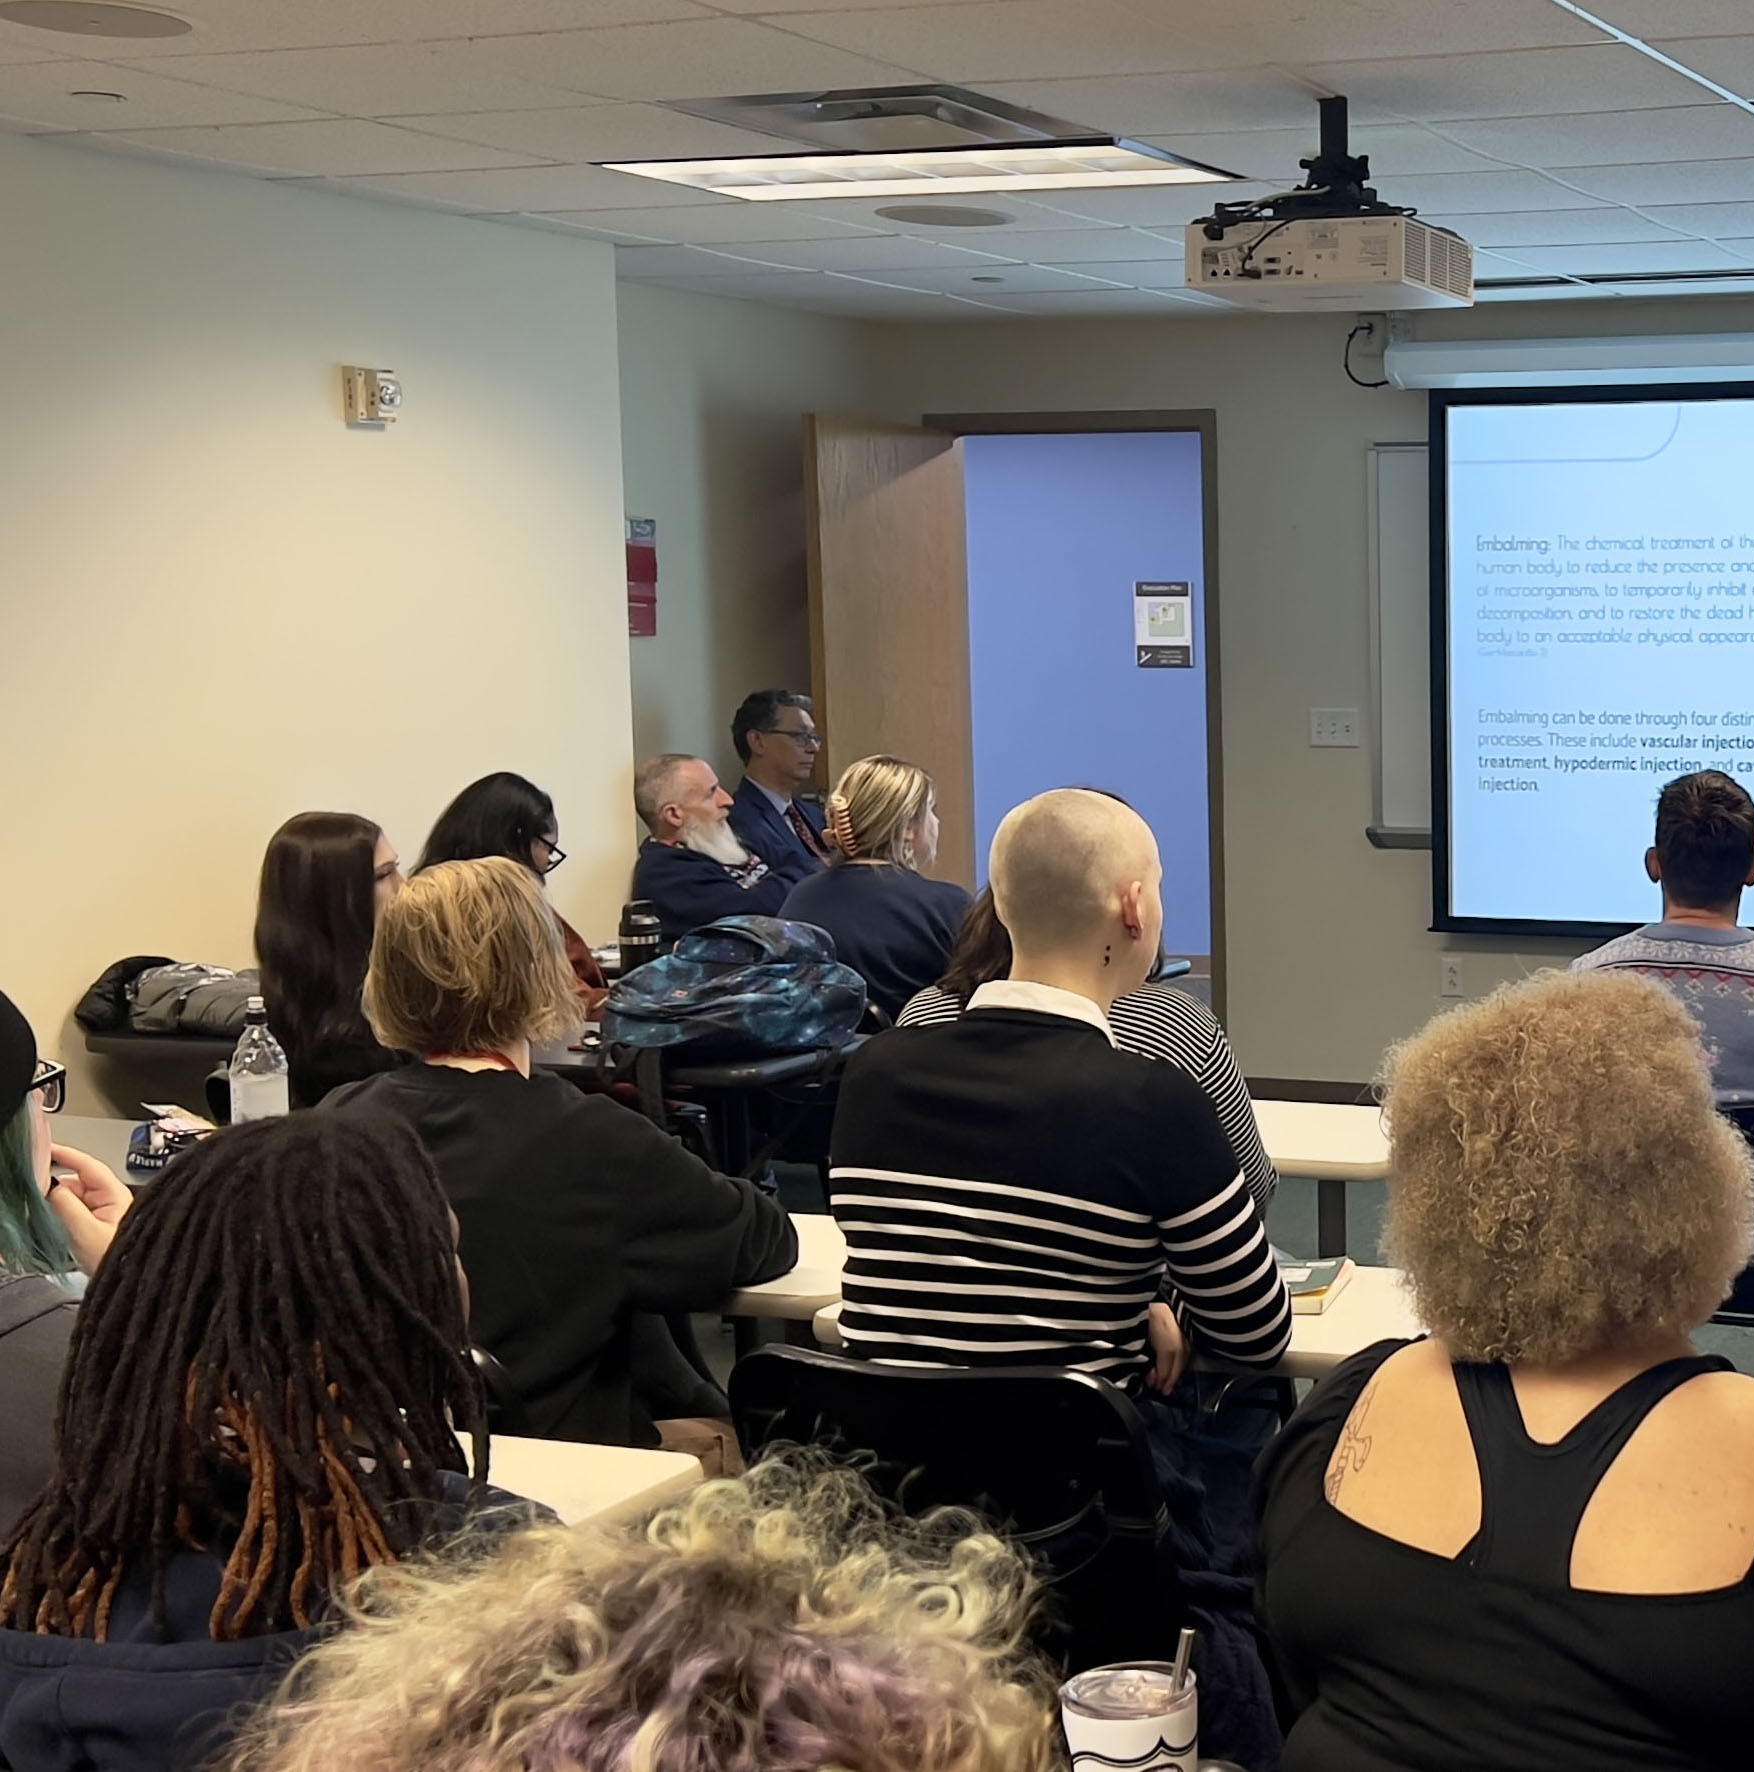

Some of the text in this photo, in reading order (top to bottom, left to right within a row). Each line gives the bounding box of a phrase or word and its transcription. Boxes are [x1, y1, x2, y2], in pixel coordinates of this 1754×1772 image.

[1557, 533, 1580, 552] The
[1585, 535, 1645, 551] chemical
[1650, 535, 1715, 551] treatment
[1476, 561, 1522, 575] human
[1526, 558, 1563, 578] body
[1566, 560, 1580, 575] to
[1585, 558, 1633, 575] reduce
[1636, 558, 1659, 574] the
[1663, 561, 1726, 576] presence
[1604, 583, 1619, 598] to
[1623, 580, 1702, 601] temporarily
[1706, 580, 1747, 597] inhibit
[1578, 603, 1606, 621] and
[1610, 606, 1625, 621] to
[1629, 606, 1676, 621] restore
[1680, 604, 1702, 621] the
[1706, 604, 1744, 621] dead
[1476, 628, 1513, 647] body
[1516, 631, 1530, 644] to
[1534, 632, 1553, 644] an
[1557, 627, 1633, 644] acceptable
[1637, 628, 1694, 647] physical
[1477, 708, 1549, 728] Embalming
[1552, 712, 1576, 725] can
[1578, 709, 1596, 726] be
[1598, 710, 1632, 726] done
[1635, 710, 1688, 730] through
[1691, 710, 1719, 727] four
[1548, 732, 1587, 748] These
[1589, 732, 1638, 749] include
[1640, 733, 1699, 749] vascular
[1553, 755, 1638, 773] hypodermic
